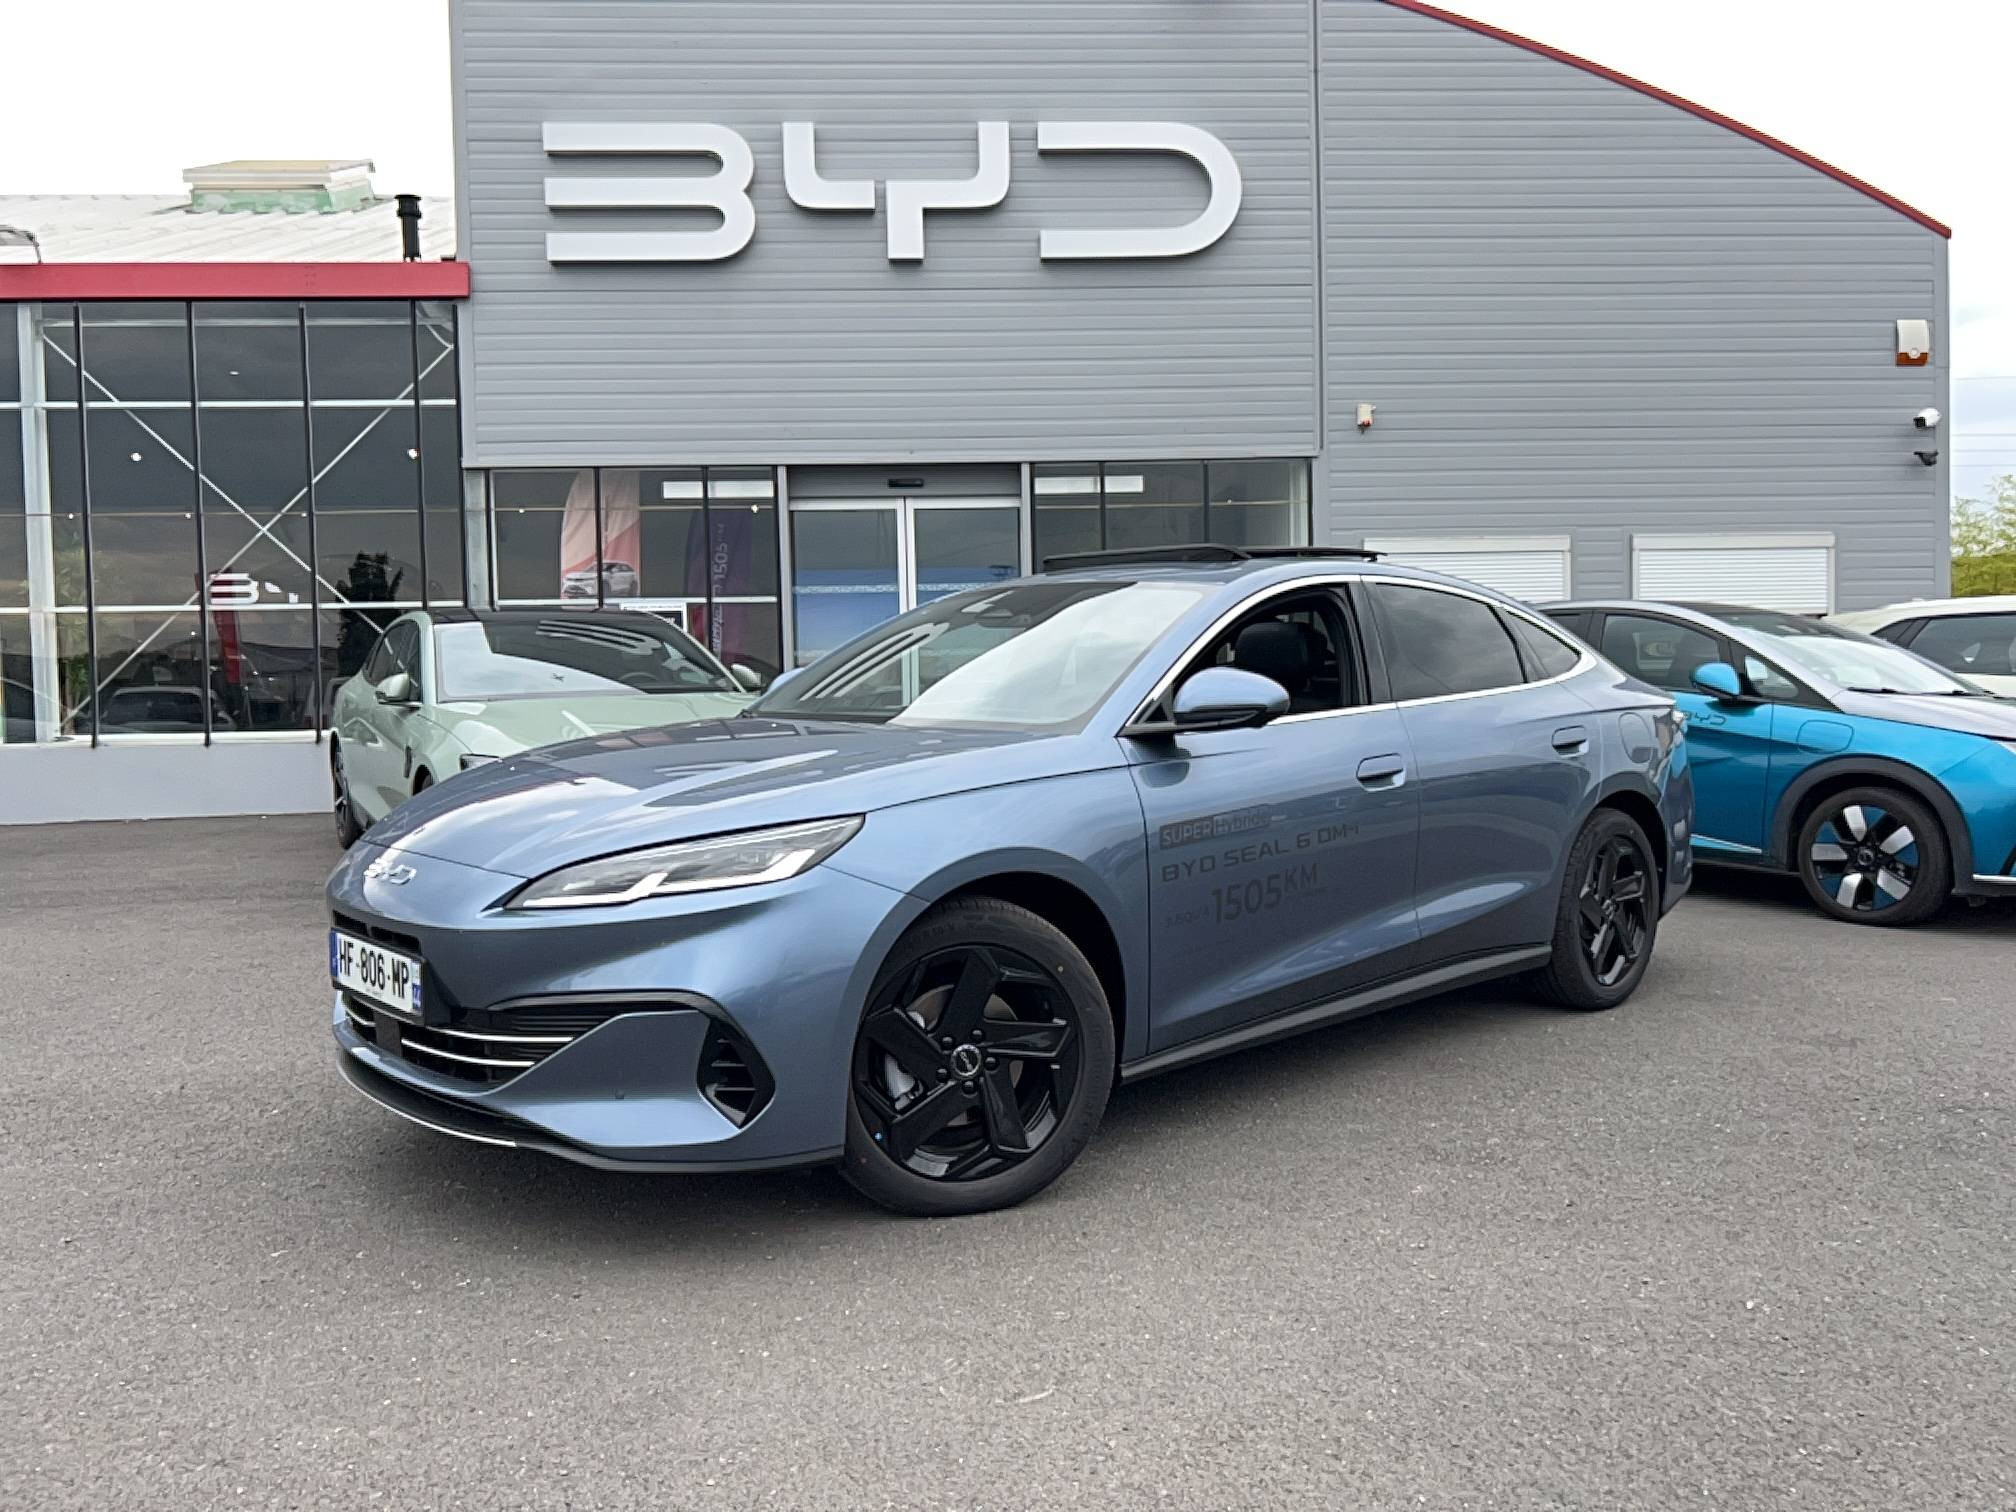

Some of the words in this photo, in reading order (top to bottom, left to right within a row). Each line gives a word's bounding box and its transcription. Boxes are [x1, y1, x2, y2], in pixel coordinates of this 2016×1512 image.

[542, 121, 1243, 262] BYD
[1161, 820, 1213, 848] SUPER
[1161, 854, 1216, 883] BYD
[1223, 837, 1290, 868] SEAL
[1296, 831, 1312, 849] 6
